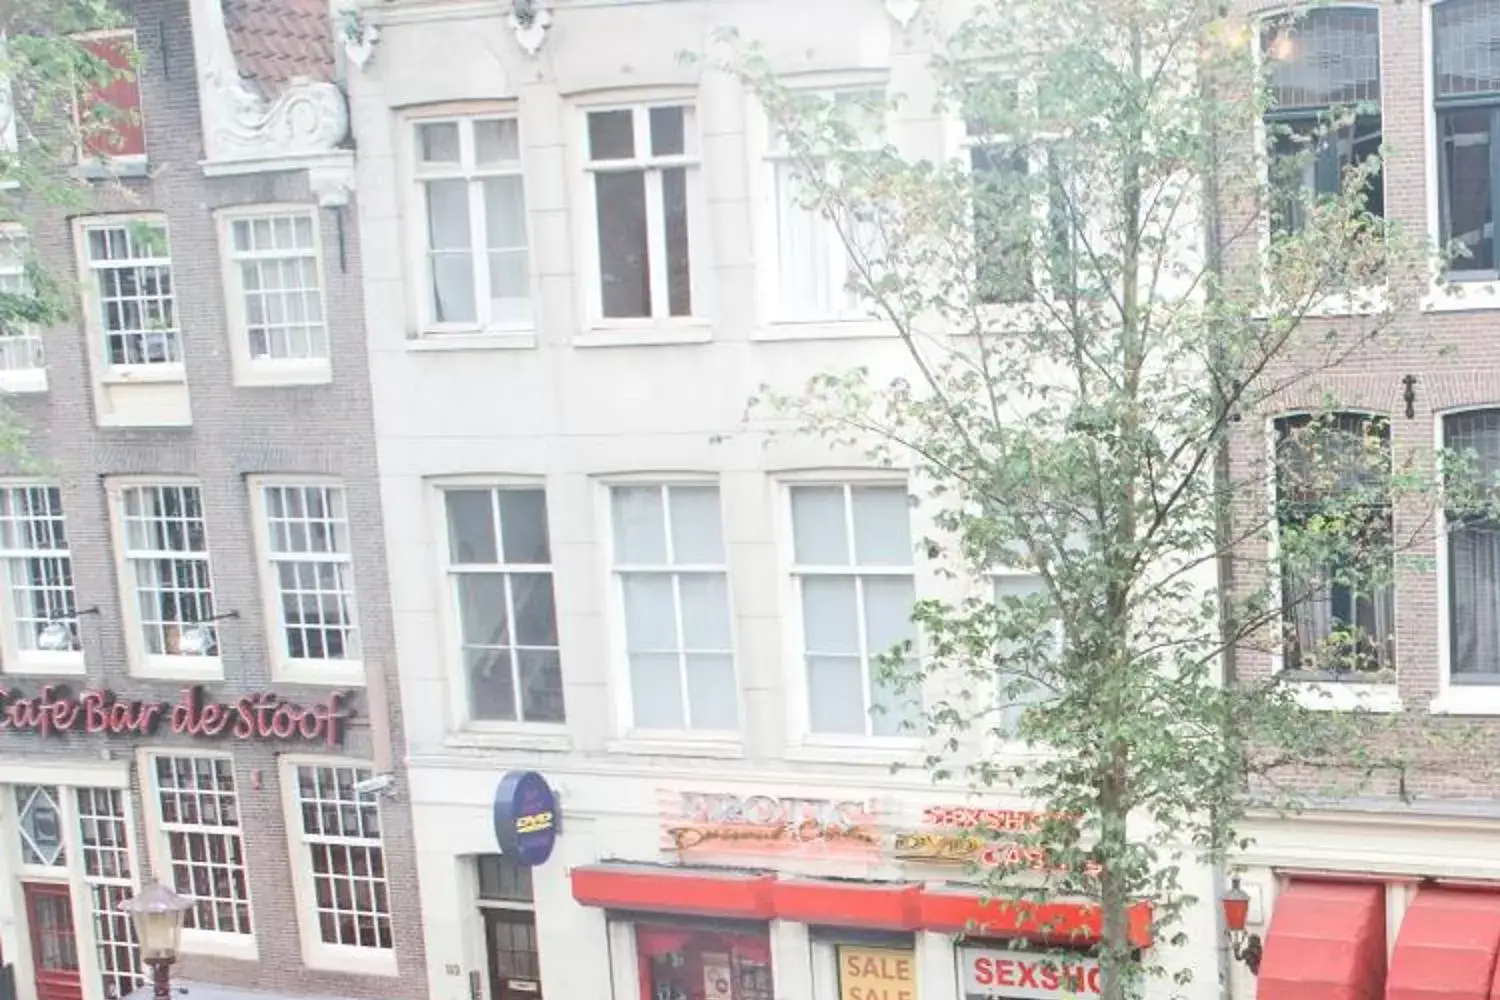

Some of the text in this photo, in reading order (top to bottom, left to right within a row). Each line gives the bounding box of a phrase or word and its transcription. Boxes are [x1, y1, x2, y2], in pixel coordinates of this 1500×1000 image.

[80, 689, 159, 734] Bar
[172, 688, 229, 735] de
[847, 956, 910, 981] SALE
